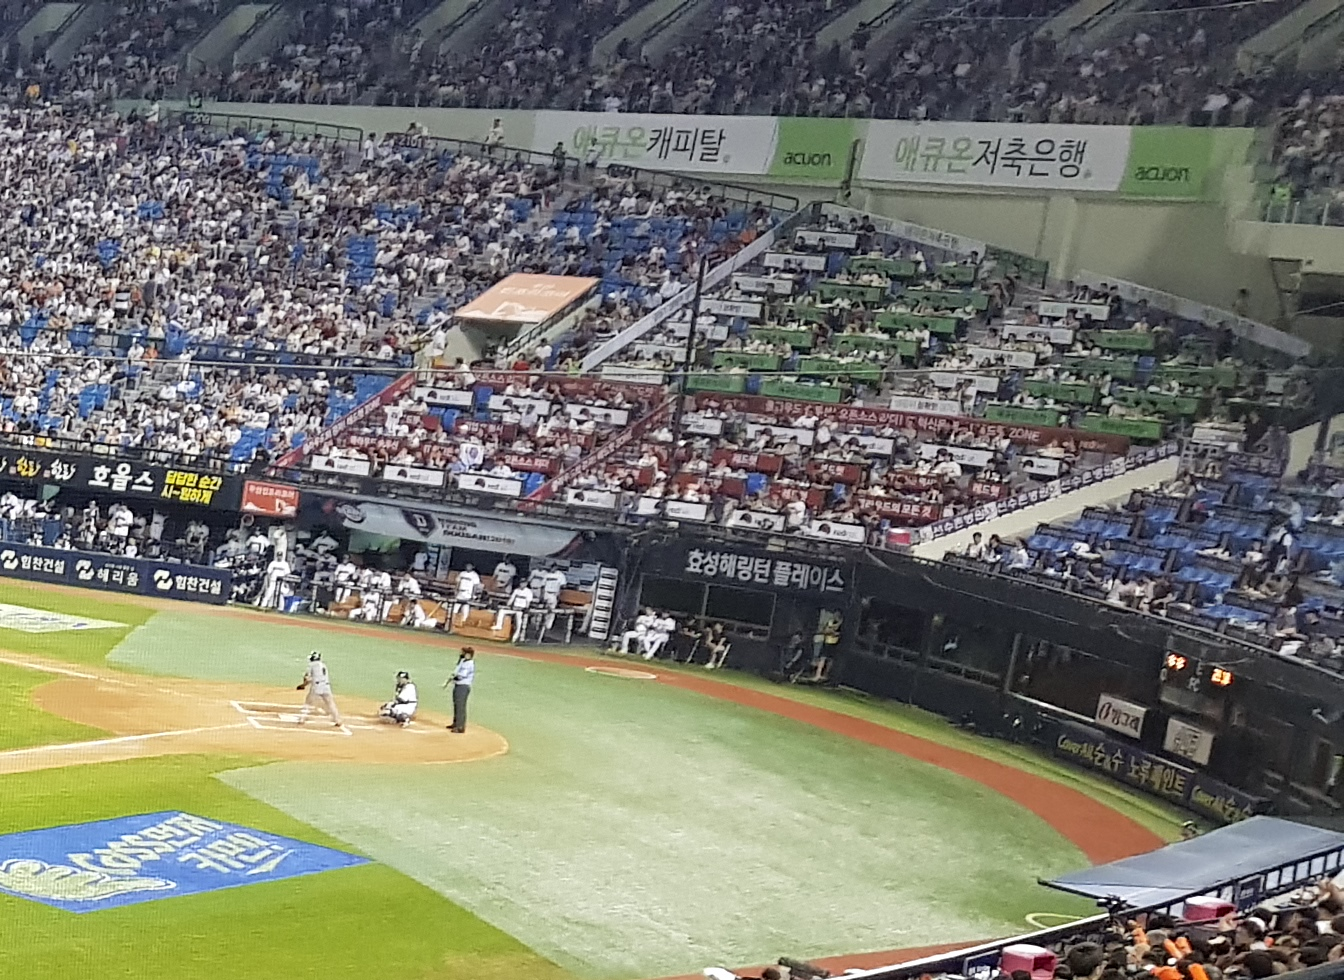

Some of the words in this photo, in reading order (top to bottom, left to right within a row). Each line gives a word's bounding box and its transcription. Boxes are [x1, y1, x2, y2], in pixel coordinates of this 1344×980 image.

[783, 151, 832, 167] acuon
[895, 137, 1088, 179] 애큐온저축은행
[1134, 165, 1191, 183] acuon
[198, 473, 223, 491] 순간
[20, 553, 66, 575] 힘찬건설
[175, 573, 223, 596] 힘찬건설
[773, 561, 845, 593] 플레이스
